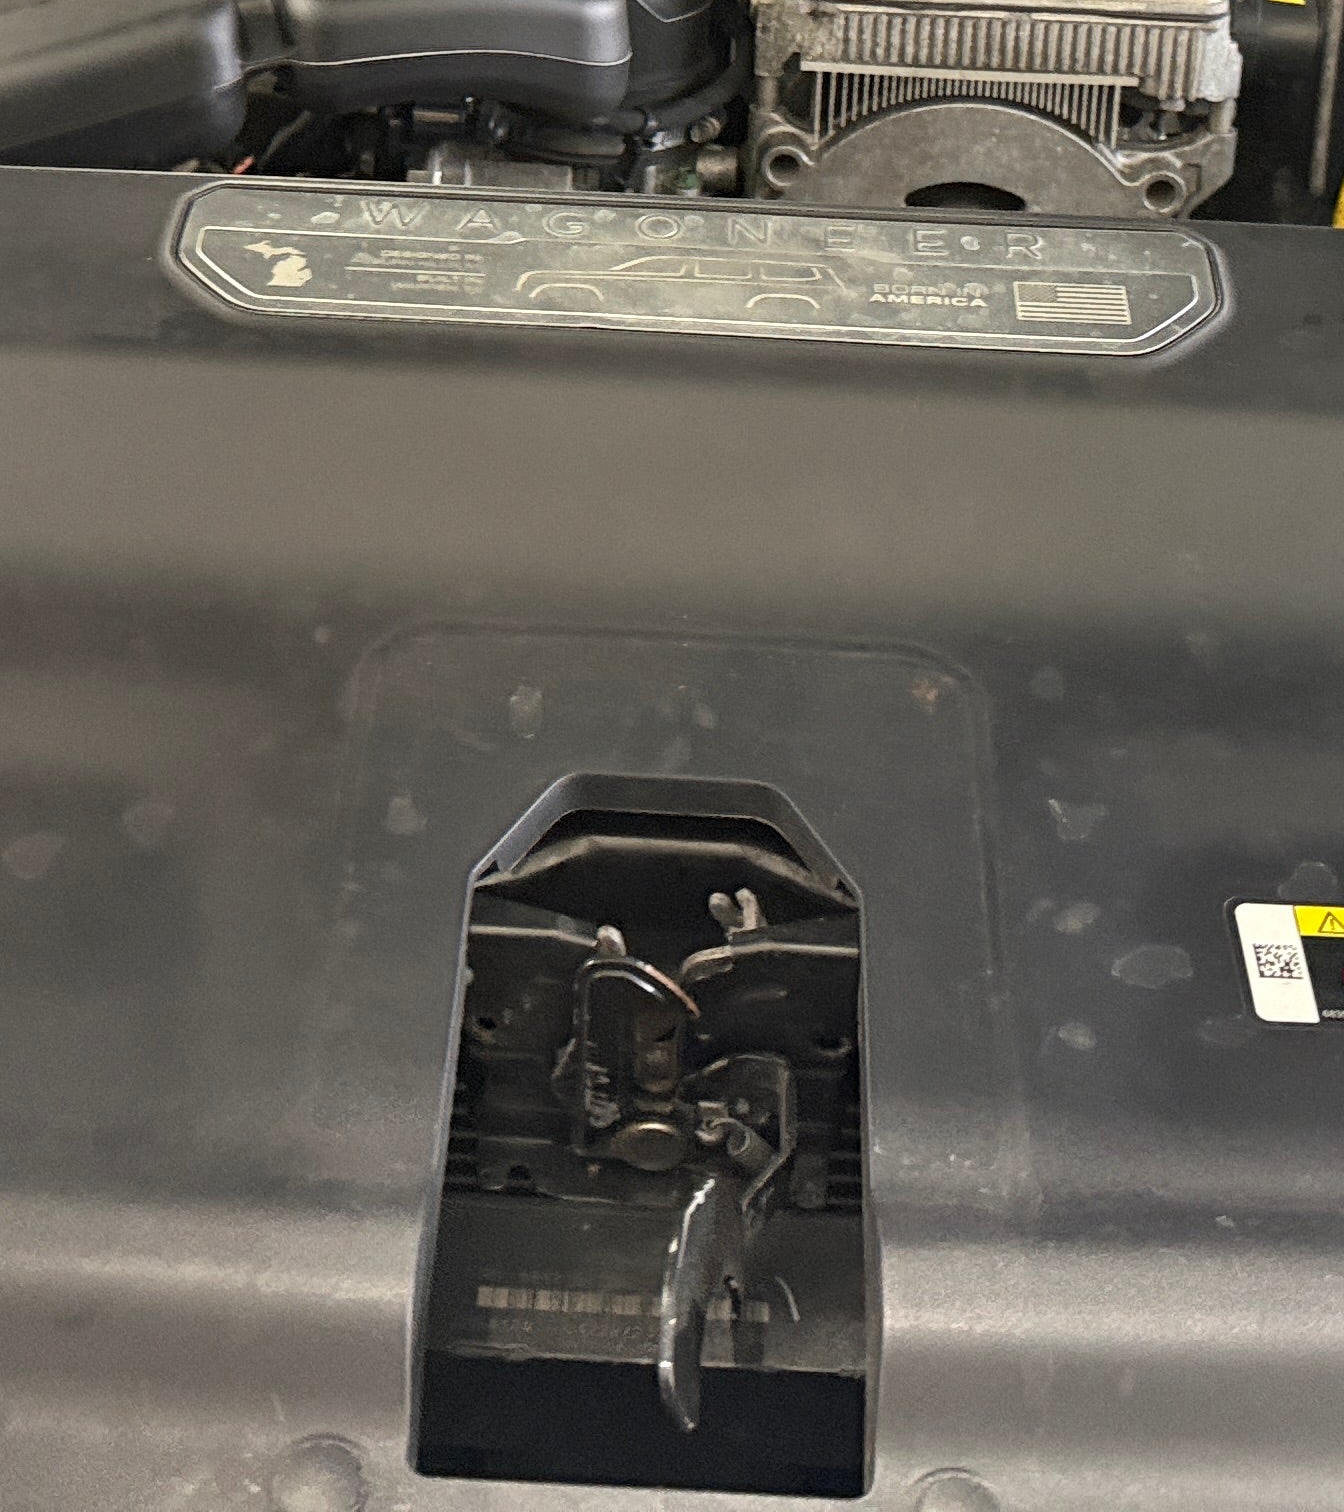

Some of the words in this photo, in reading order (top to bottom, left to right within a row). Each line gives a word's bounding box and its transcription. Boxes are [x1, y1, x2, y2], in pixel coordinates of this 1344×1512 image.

[359, 199, 1044, 260] WAGONEER
[873, 283, 945, 296] BORN
[869, 293, 989, 307] AMERICA
